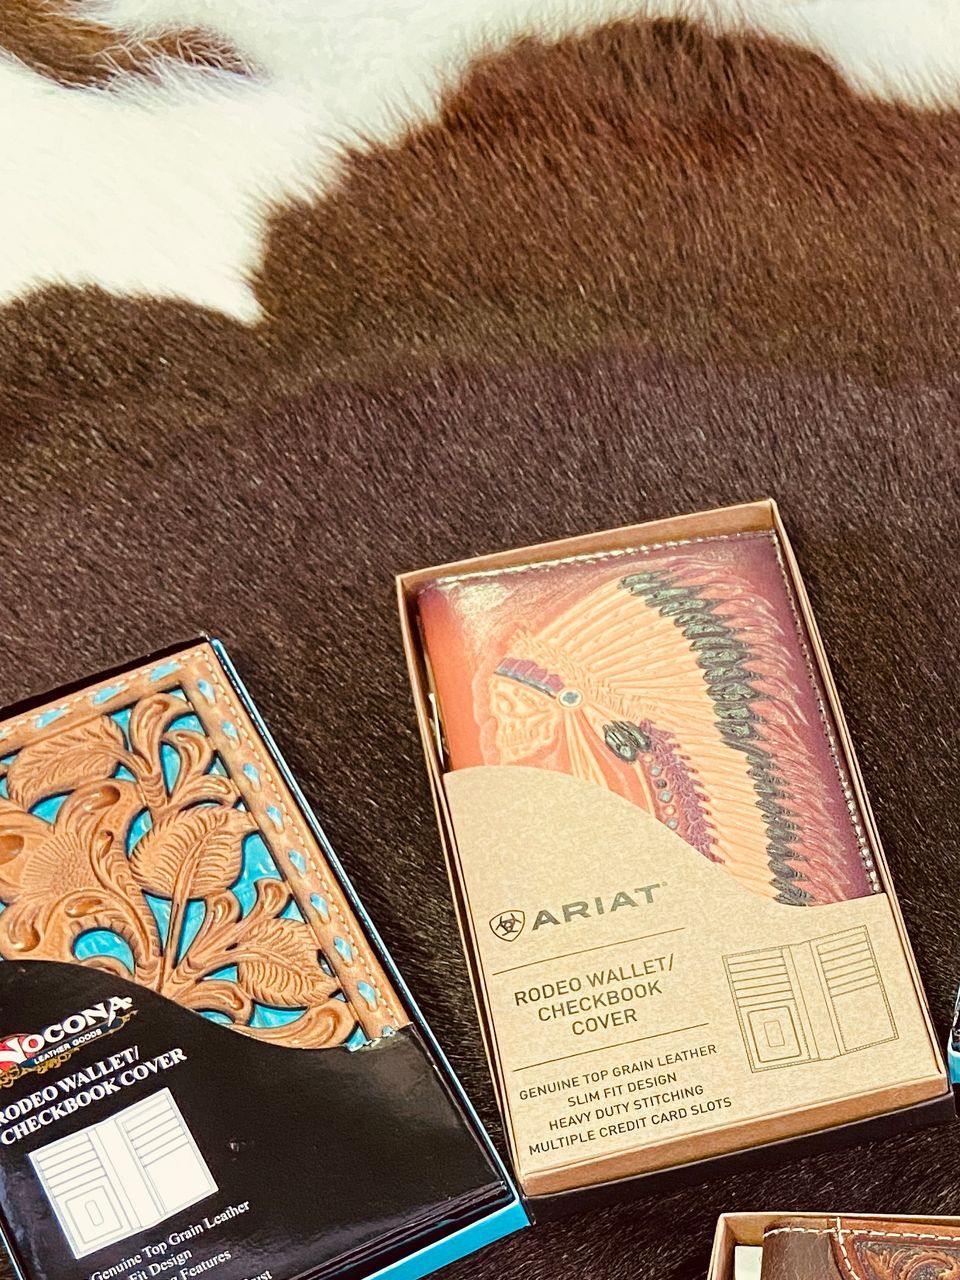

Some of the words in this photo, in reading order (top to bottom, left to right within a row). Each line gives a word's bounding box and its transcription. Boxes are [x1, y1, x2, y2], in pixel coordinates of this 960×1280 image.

[532, 884, 661, 931] ARIAT
[514, 977, 582, 1006] RODEO
[586, 953, 674, 988] WALLET/
[538, 980, 663, 1022] CHECKBOOK
[572, 1008, 637, 1035] COVER
[33, 1042, 71, 1064] LEATHER
[72, 1028, 102, 1046] GOODS
[56, 1045, 139, 1093] WALLET/
[519, 1076, 580, 1100] GENUINE
[583, 1070, 609, 1085] TOP
[612, 1059, 654, 1078] GRAIN
[657, 1044, 717, 1067] LEATHER
[568, 1092, 600, 1108] SLIM
[603, 1084, 623, 1099] FIT
[628, 1072, 677, 1093] DESIGN
[1, 1078, 121, 1145] CHECKBOOK
[120, 1048, 187, 1086] COVER
[549, 1111, 591, 1131] HEAVY
[595, 1102, 630, 1120] DUTY
[633, 1085, 704, 1110] STITCHING
[529, 1130, 597, 1156] MULTIPLE
[599, 1117, 647, 1138] CREDIT
[651, 1108, 687, 1125] CARD
[691, 1097, 732, 1116] SLOTS
[142, 1241, 168, 1258] Top
[168, 1223, 204, 1246] Grain
[203, 1200, 251, 1229] Leather
[148, 1249, 193, 1277] Design
[180, 1250, 232, 1280] Features
